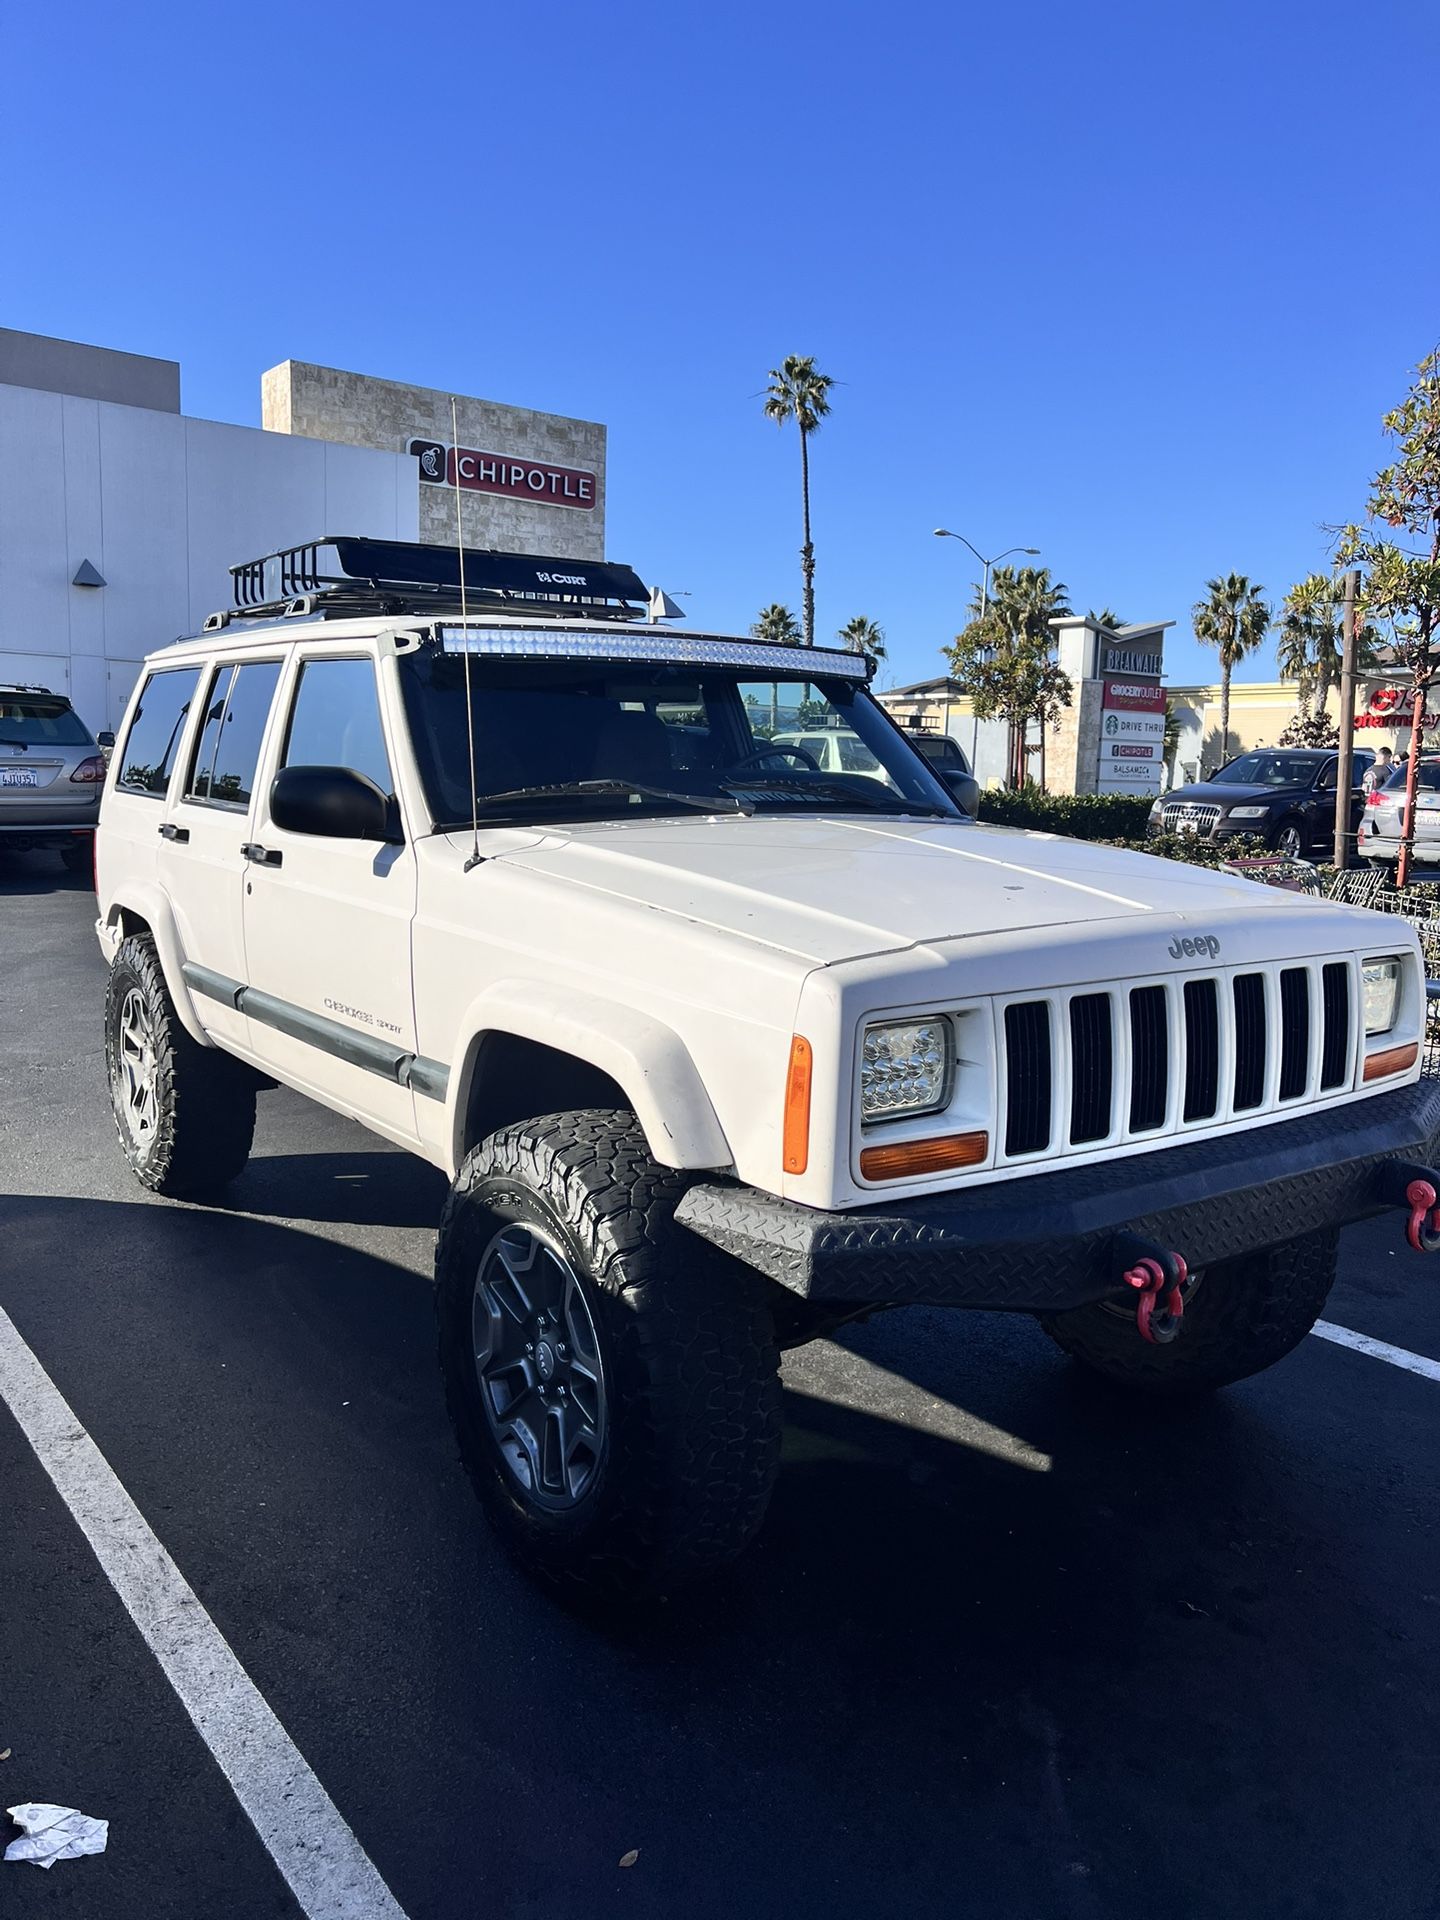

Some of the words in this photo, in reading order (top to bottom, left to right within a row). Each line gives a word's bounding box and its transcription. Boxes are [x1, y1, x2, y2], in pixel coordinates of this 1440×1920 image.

[458, 456, 592, 500] CHIPOTLE
[551, 573, 587, 586] CURT
[1107, 649, 1163, 674] BREAKWATER
[1120, 721, 1142, 732] DRIVE
[1145, 722, 1164, 733] THRU
[1121, 746, 1152, 756] CHIPOTLE
[1168, 934, 1220, 959] Jeep
